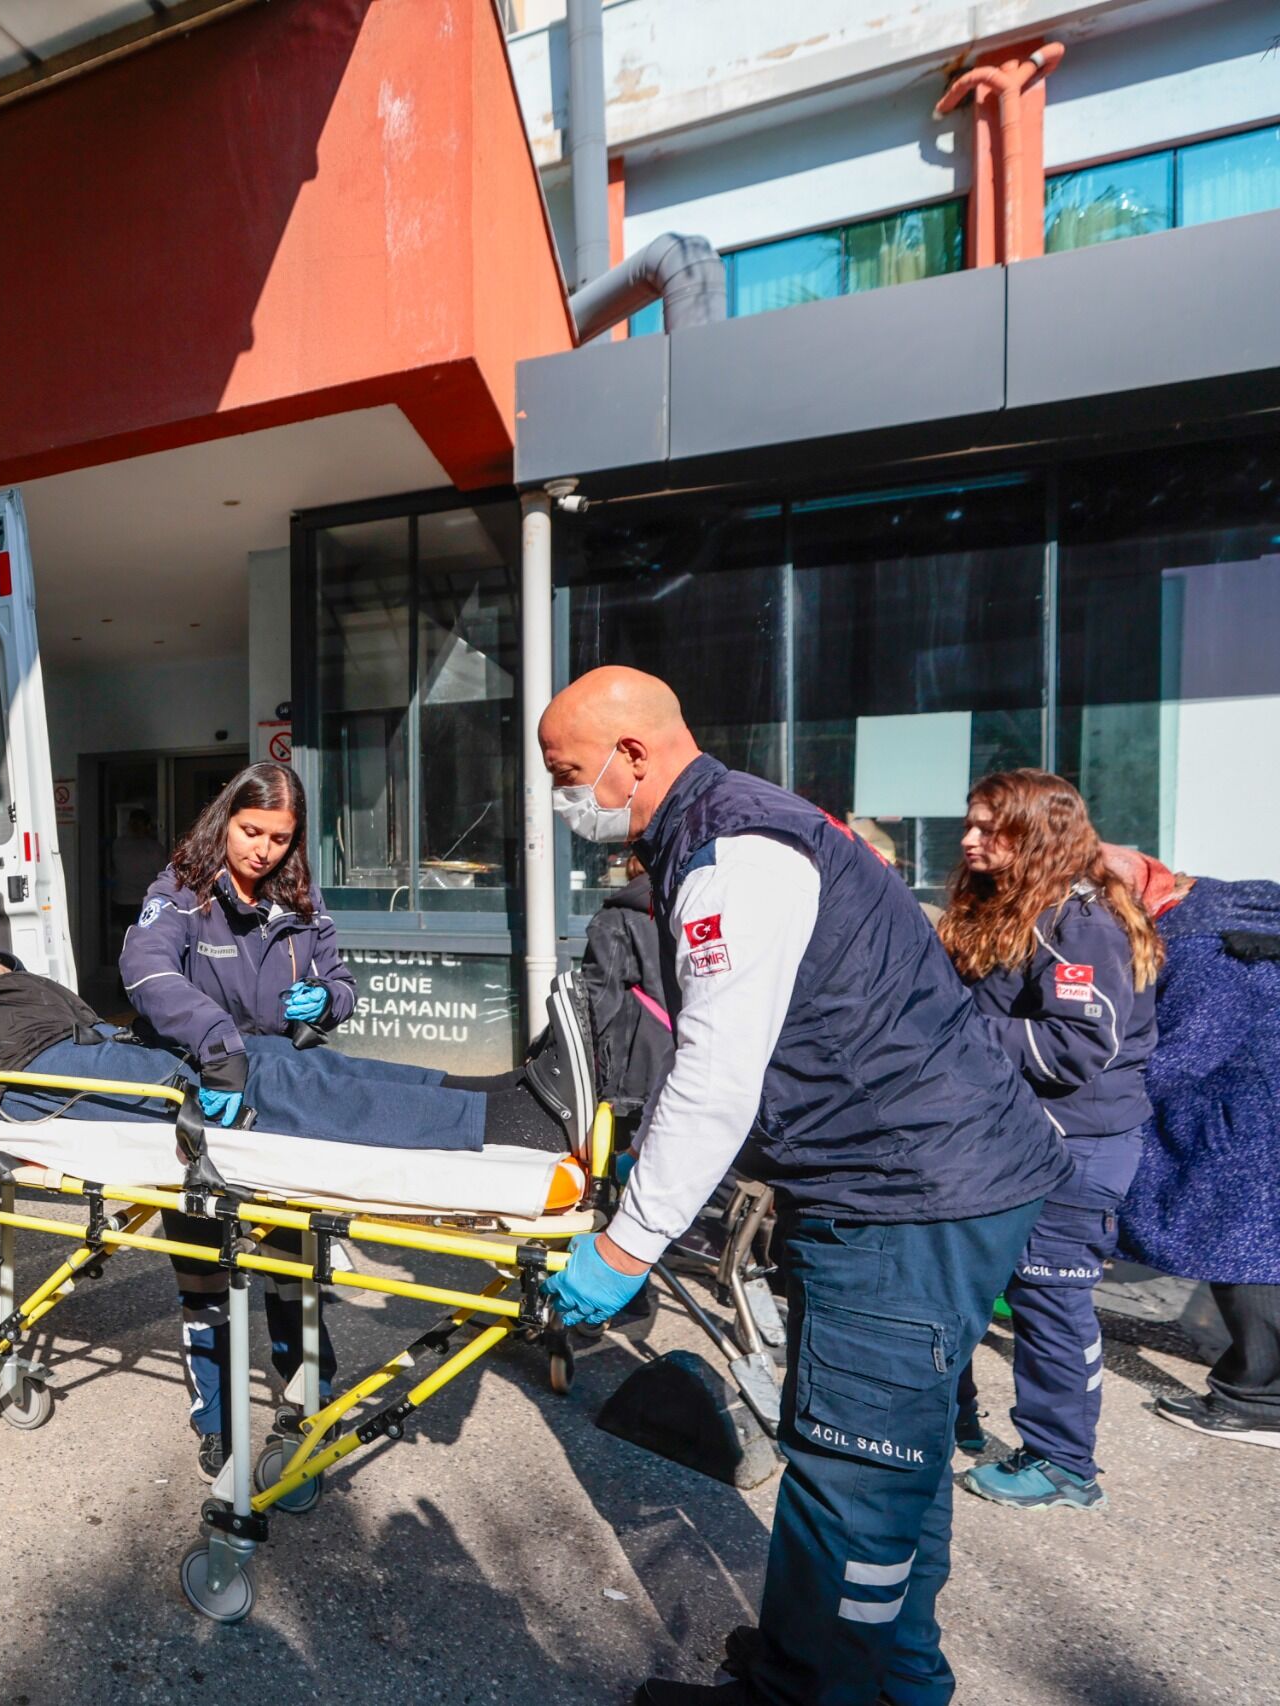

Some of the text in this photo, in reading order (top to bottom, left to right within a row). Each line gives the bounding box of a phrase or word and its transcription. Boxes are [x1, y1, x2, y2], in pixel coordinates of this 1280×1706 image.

[370, 973, 432, 994] GÜNE
[353, 997, 477, 1020] ŞLAMANIN
[337, 1017, 468, 1042] EN İYİ YOLU
[857, 1437, 924, 1463] SAĞLIK
